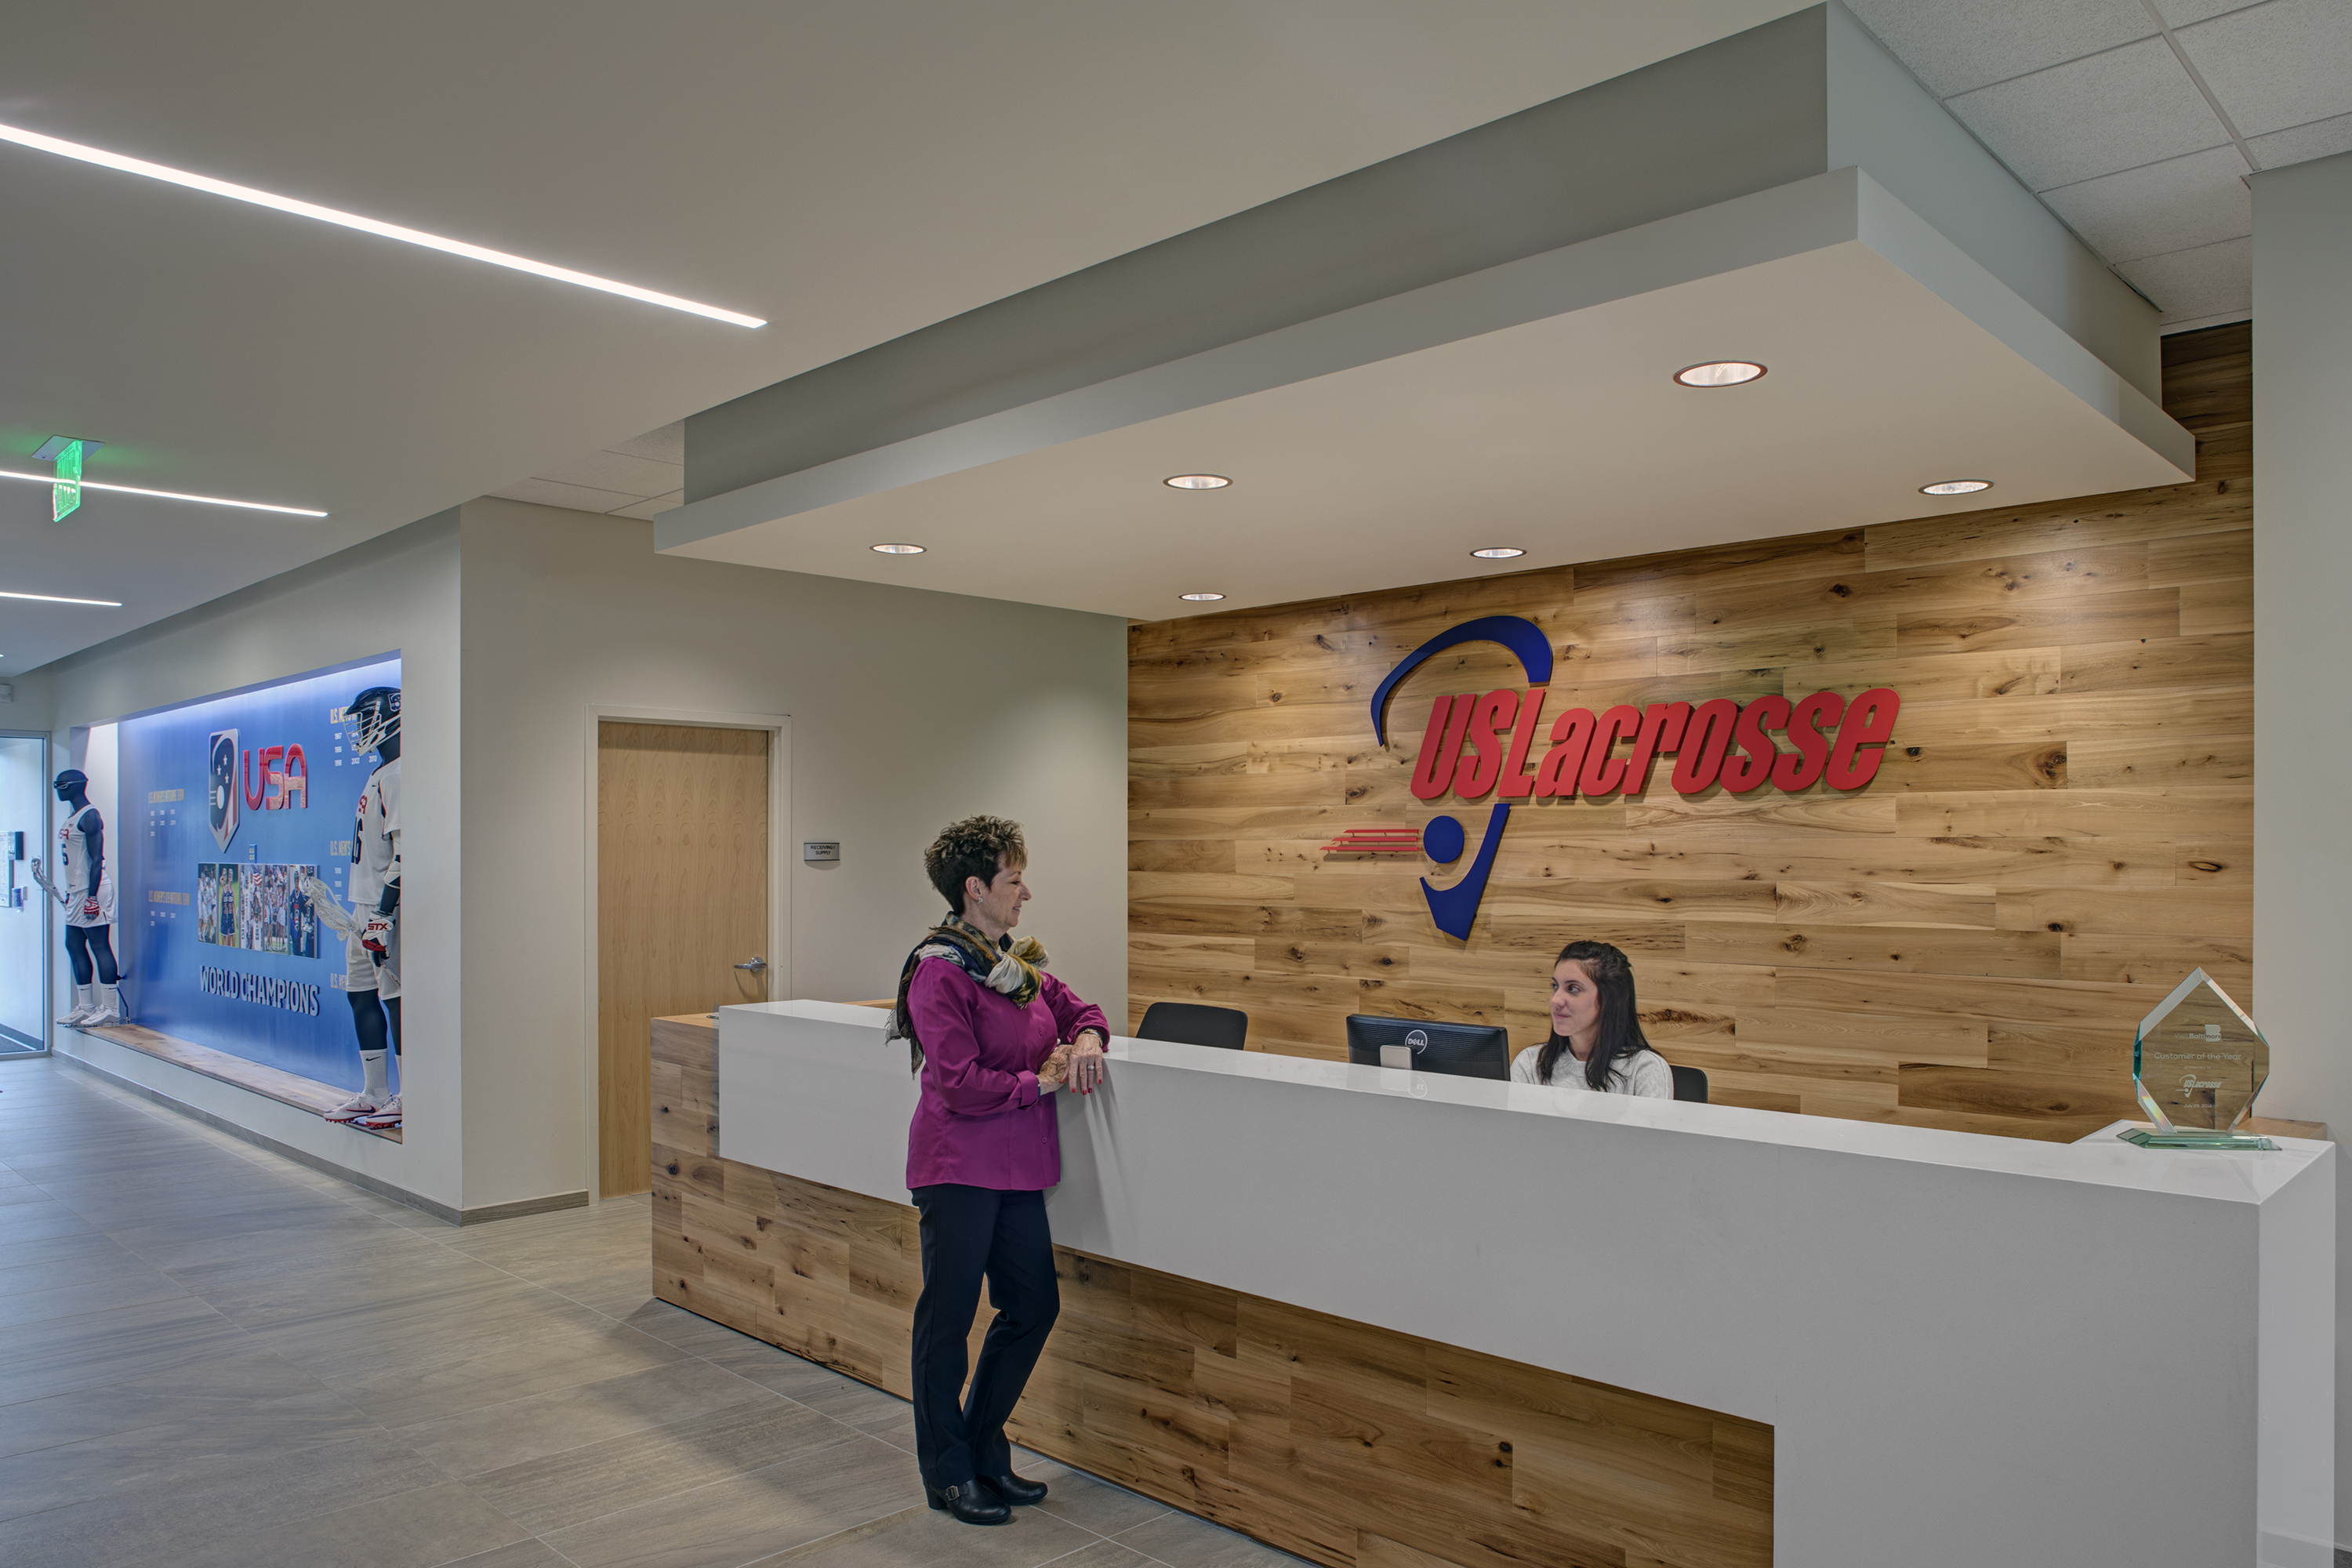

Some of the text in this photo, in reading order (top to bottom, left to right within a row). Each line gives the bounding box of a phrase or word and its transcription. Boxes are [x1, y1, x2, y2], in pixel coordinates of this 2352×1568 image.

[242, 743, 307, 811] USA
[199, 964, 320, 1017] WORLD CHAMPIONS
